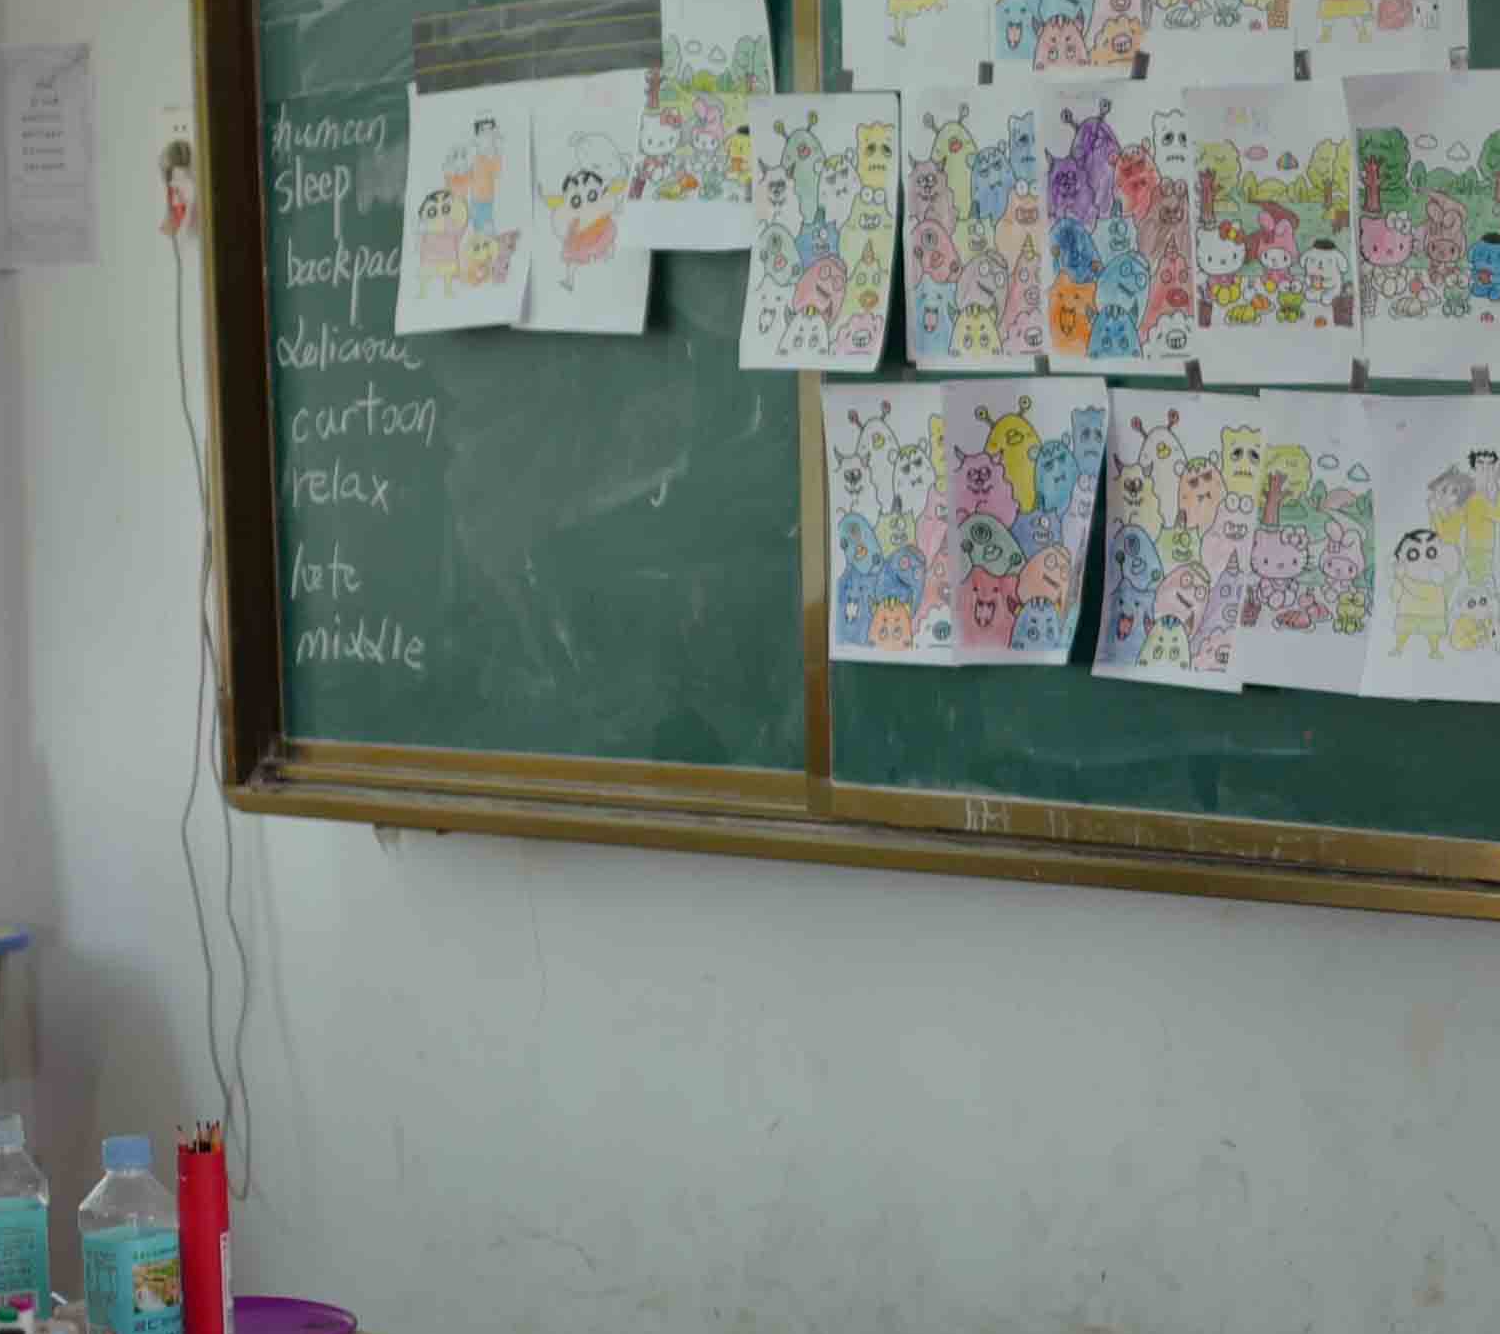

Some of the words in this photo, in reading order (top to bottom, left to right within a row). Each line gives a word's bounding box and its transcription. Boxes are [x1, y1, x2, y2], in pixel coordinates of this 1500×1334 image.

[274, 155, 352, 240] sleep
[286, 235, 400, 328] backpac
[290, 380, 437, 448] cartoon
[290, 456, 390, 516] relax
